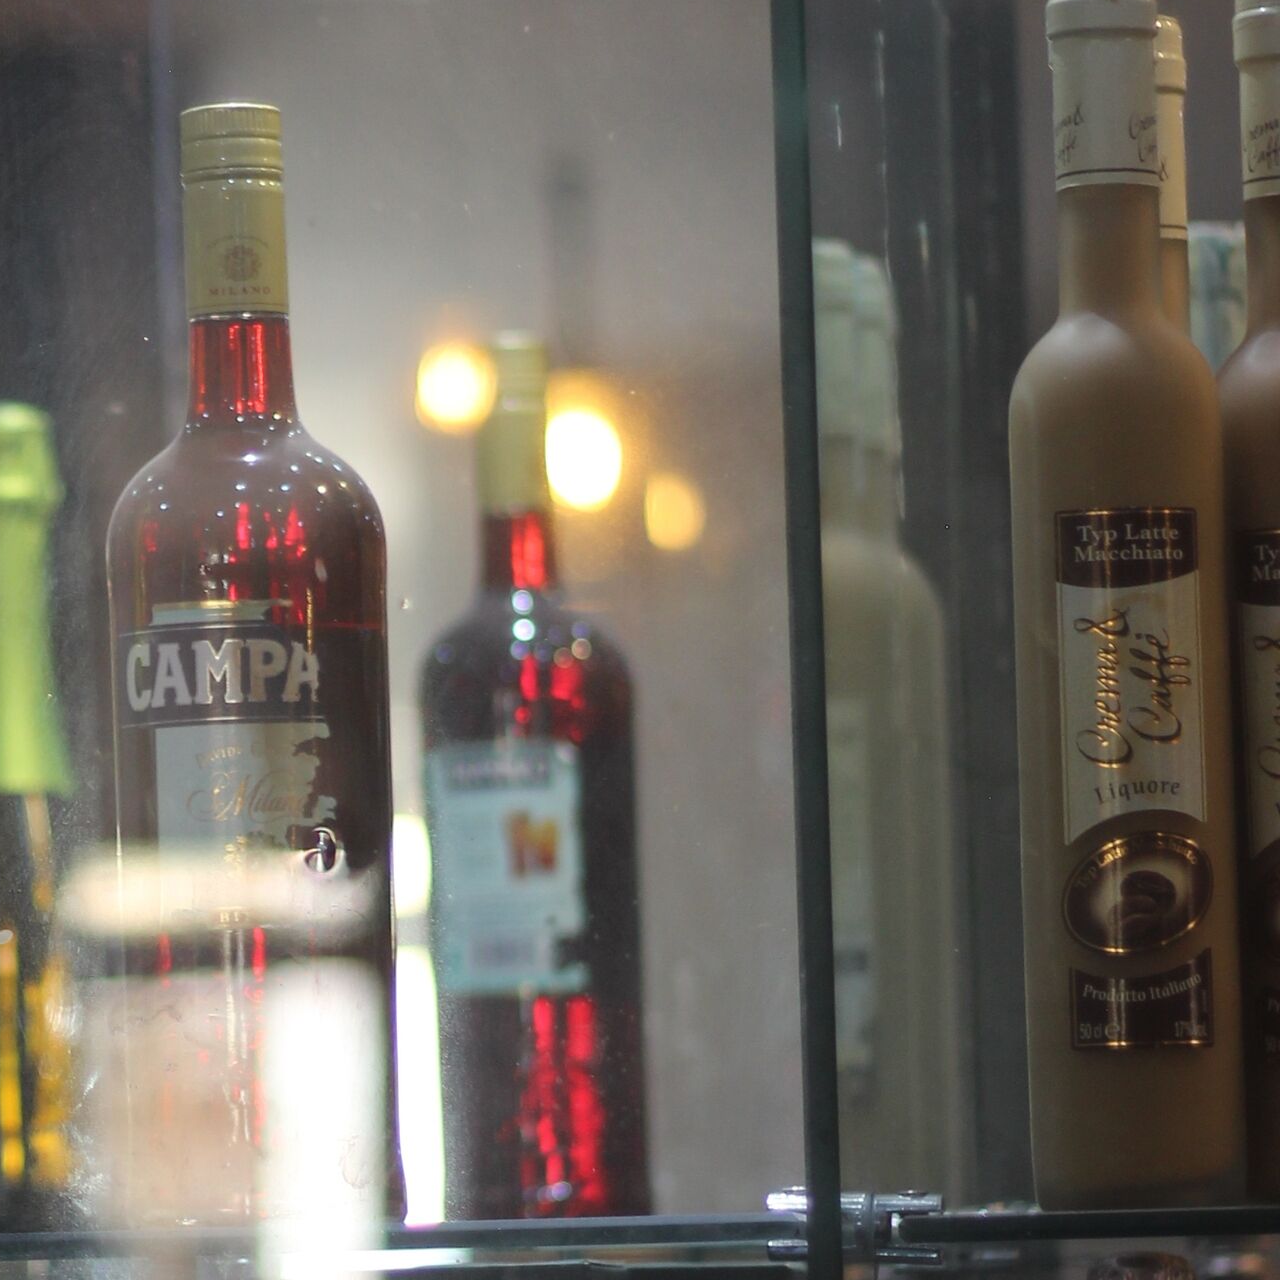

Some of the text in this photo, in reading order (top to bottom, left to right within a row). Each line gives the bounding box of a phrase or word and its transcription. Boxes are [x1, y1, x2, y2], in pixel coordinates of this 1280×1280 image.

[1076, 523, 1179, 545] Typ Latte
[1073, 544, 1184, 563] Macchiato
[1254, 544, 1280, 562] Ty
[126, 638, 320, 712] CAMPA
[1093, 777, 1181, 806] Liquore
[1081, 973, 1202, 1002] Prodotto Italiano
